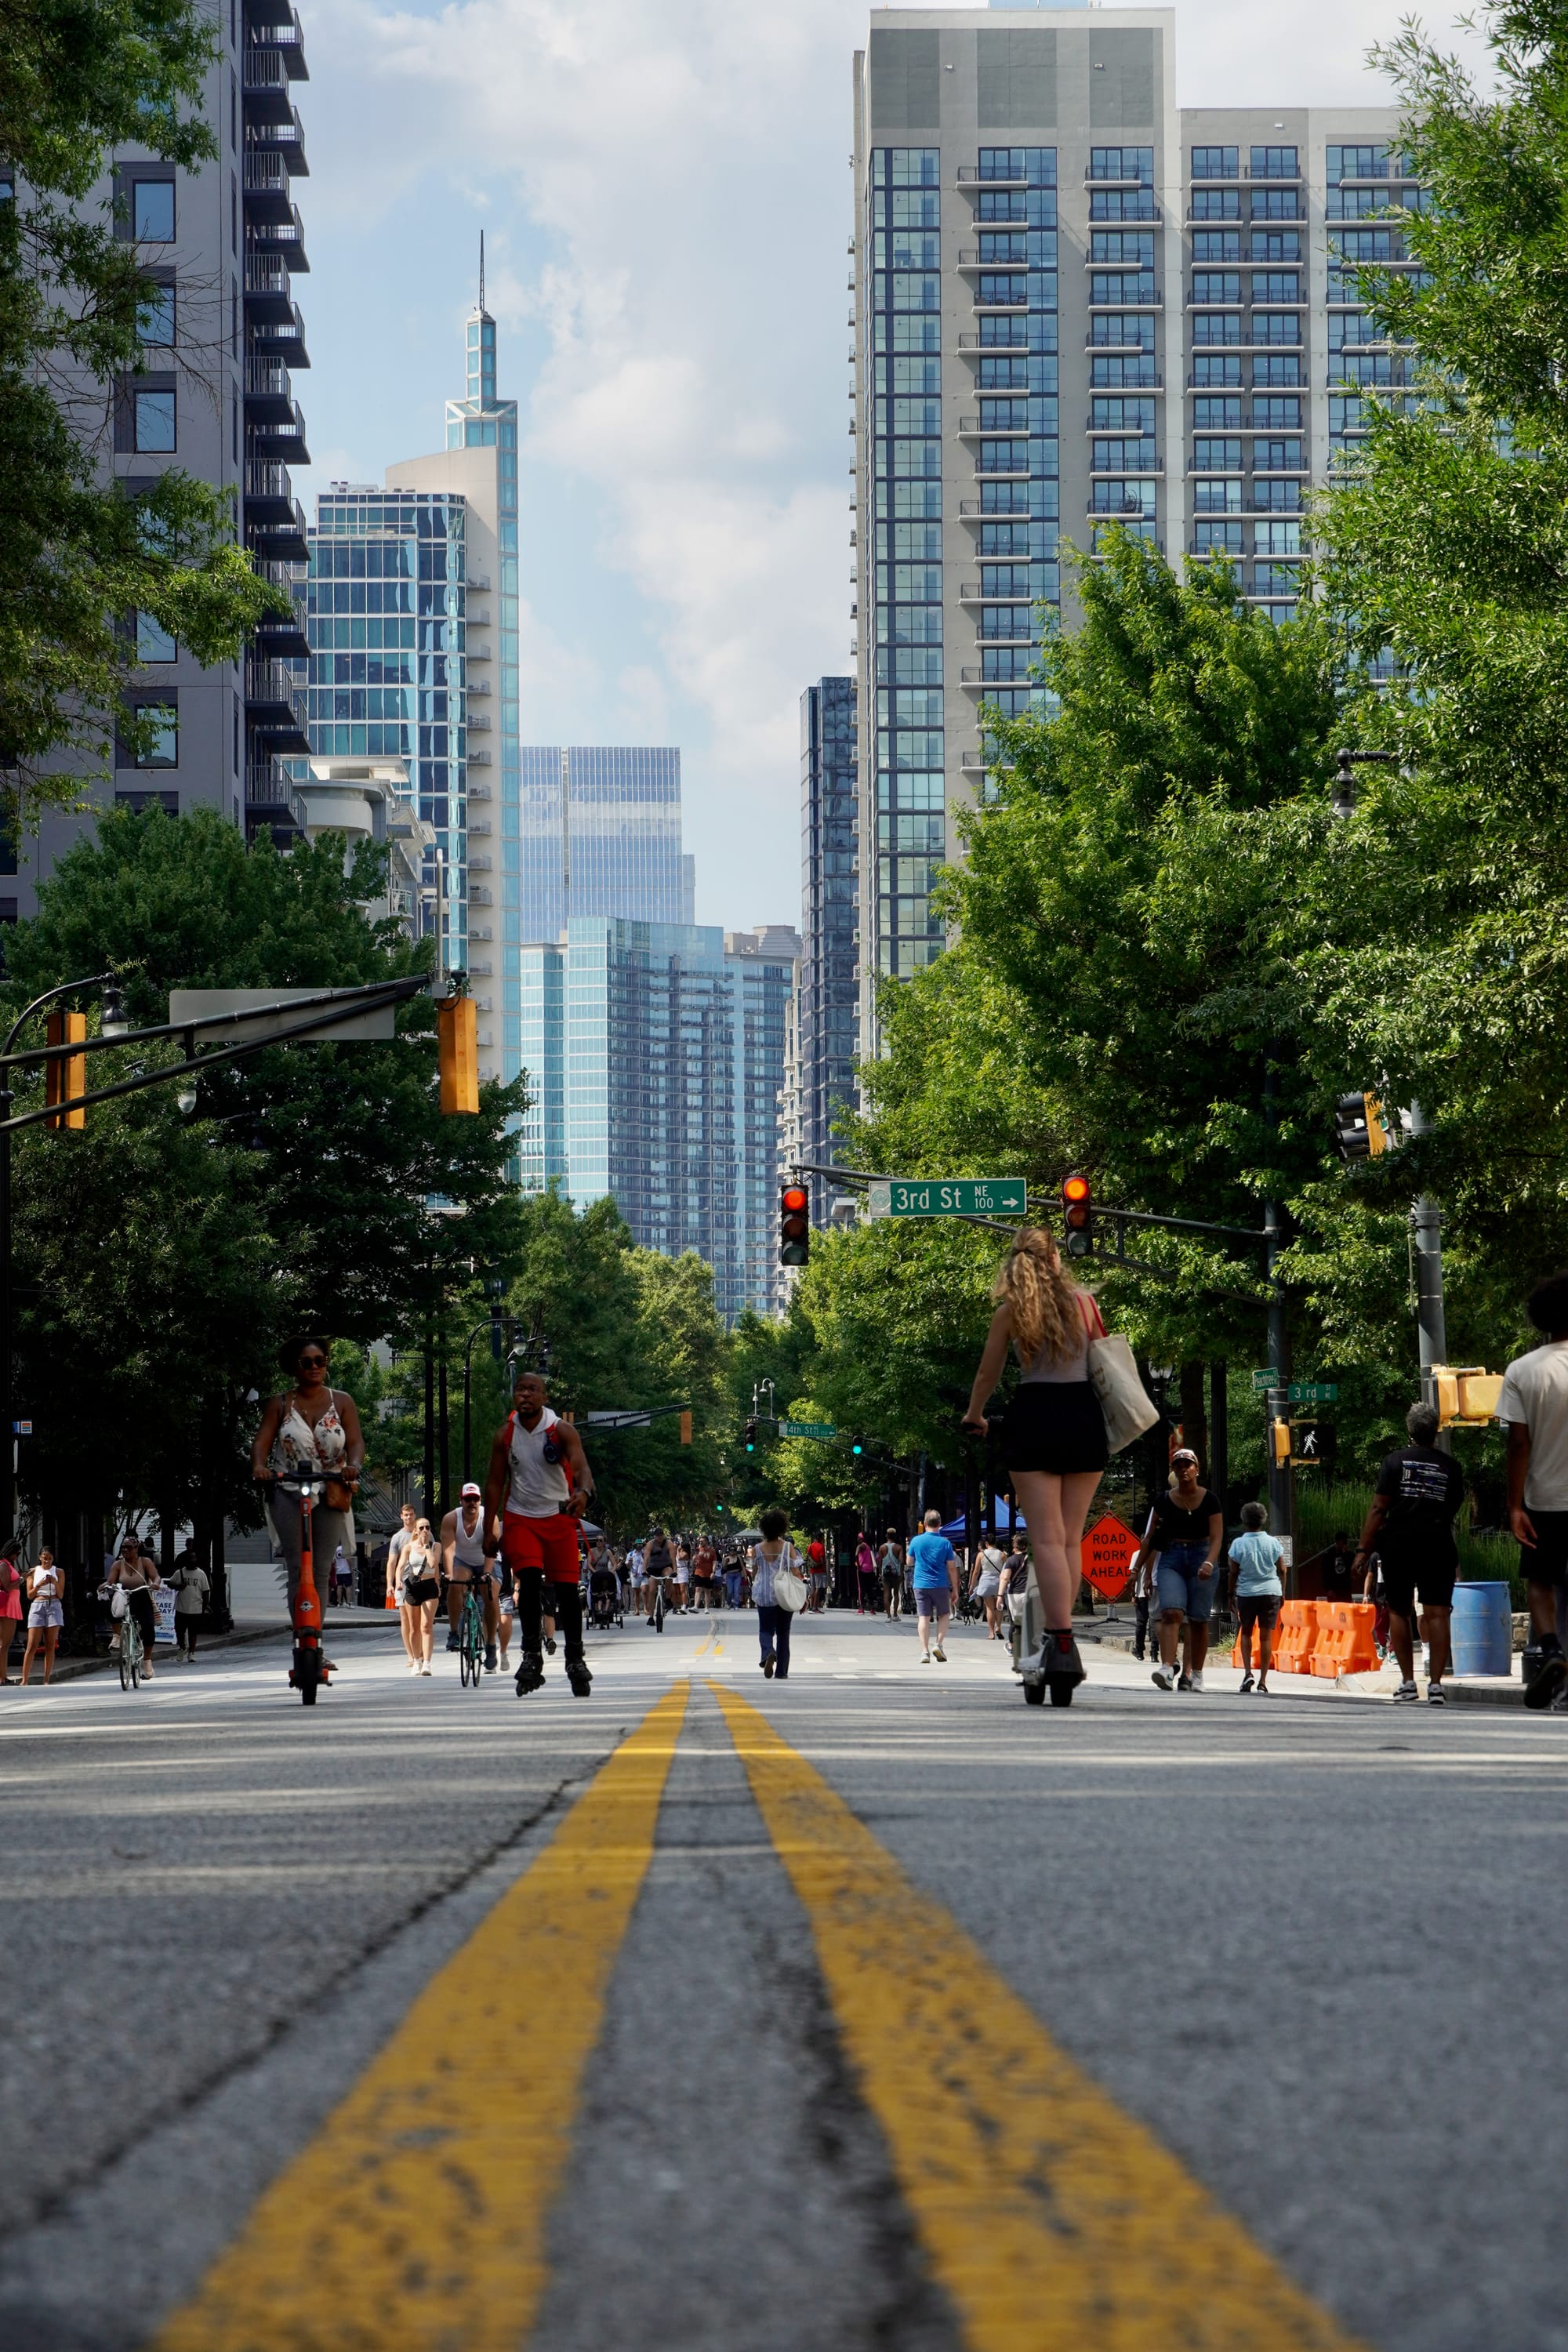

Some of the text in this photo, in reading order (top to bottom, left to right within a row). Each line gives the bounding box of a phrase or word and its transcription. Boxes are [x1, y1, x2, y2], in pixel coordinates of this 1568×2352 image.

[975, 1185, 989, 1196] NE
[896, 1186, 962, 1210] 3rd St
[975, 1198, 993, 1209] 100
[1254, 1374, 1274, 1387] Peachtree
[1294, 1387, 1317, 1399] 3 rd
[788, 1425, 812, 1435] 4th St
[1092, 1533, 1127, 1544] ROAD
[1093, 1550, 1127, 1561] WORK
[1090, 1566, 1131, 1578] AHEAD
